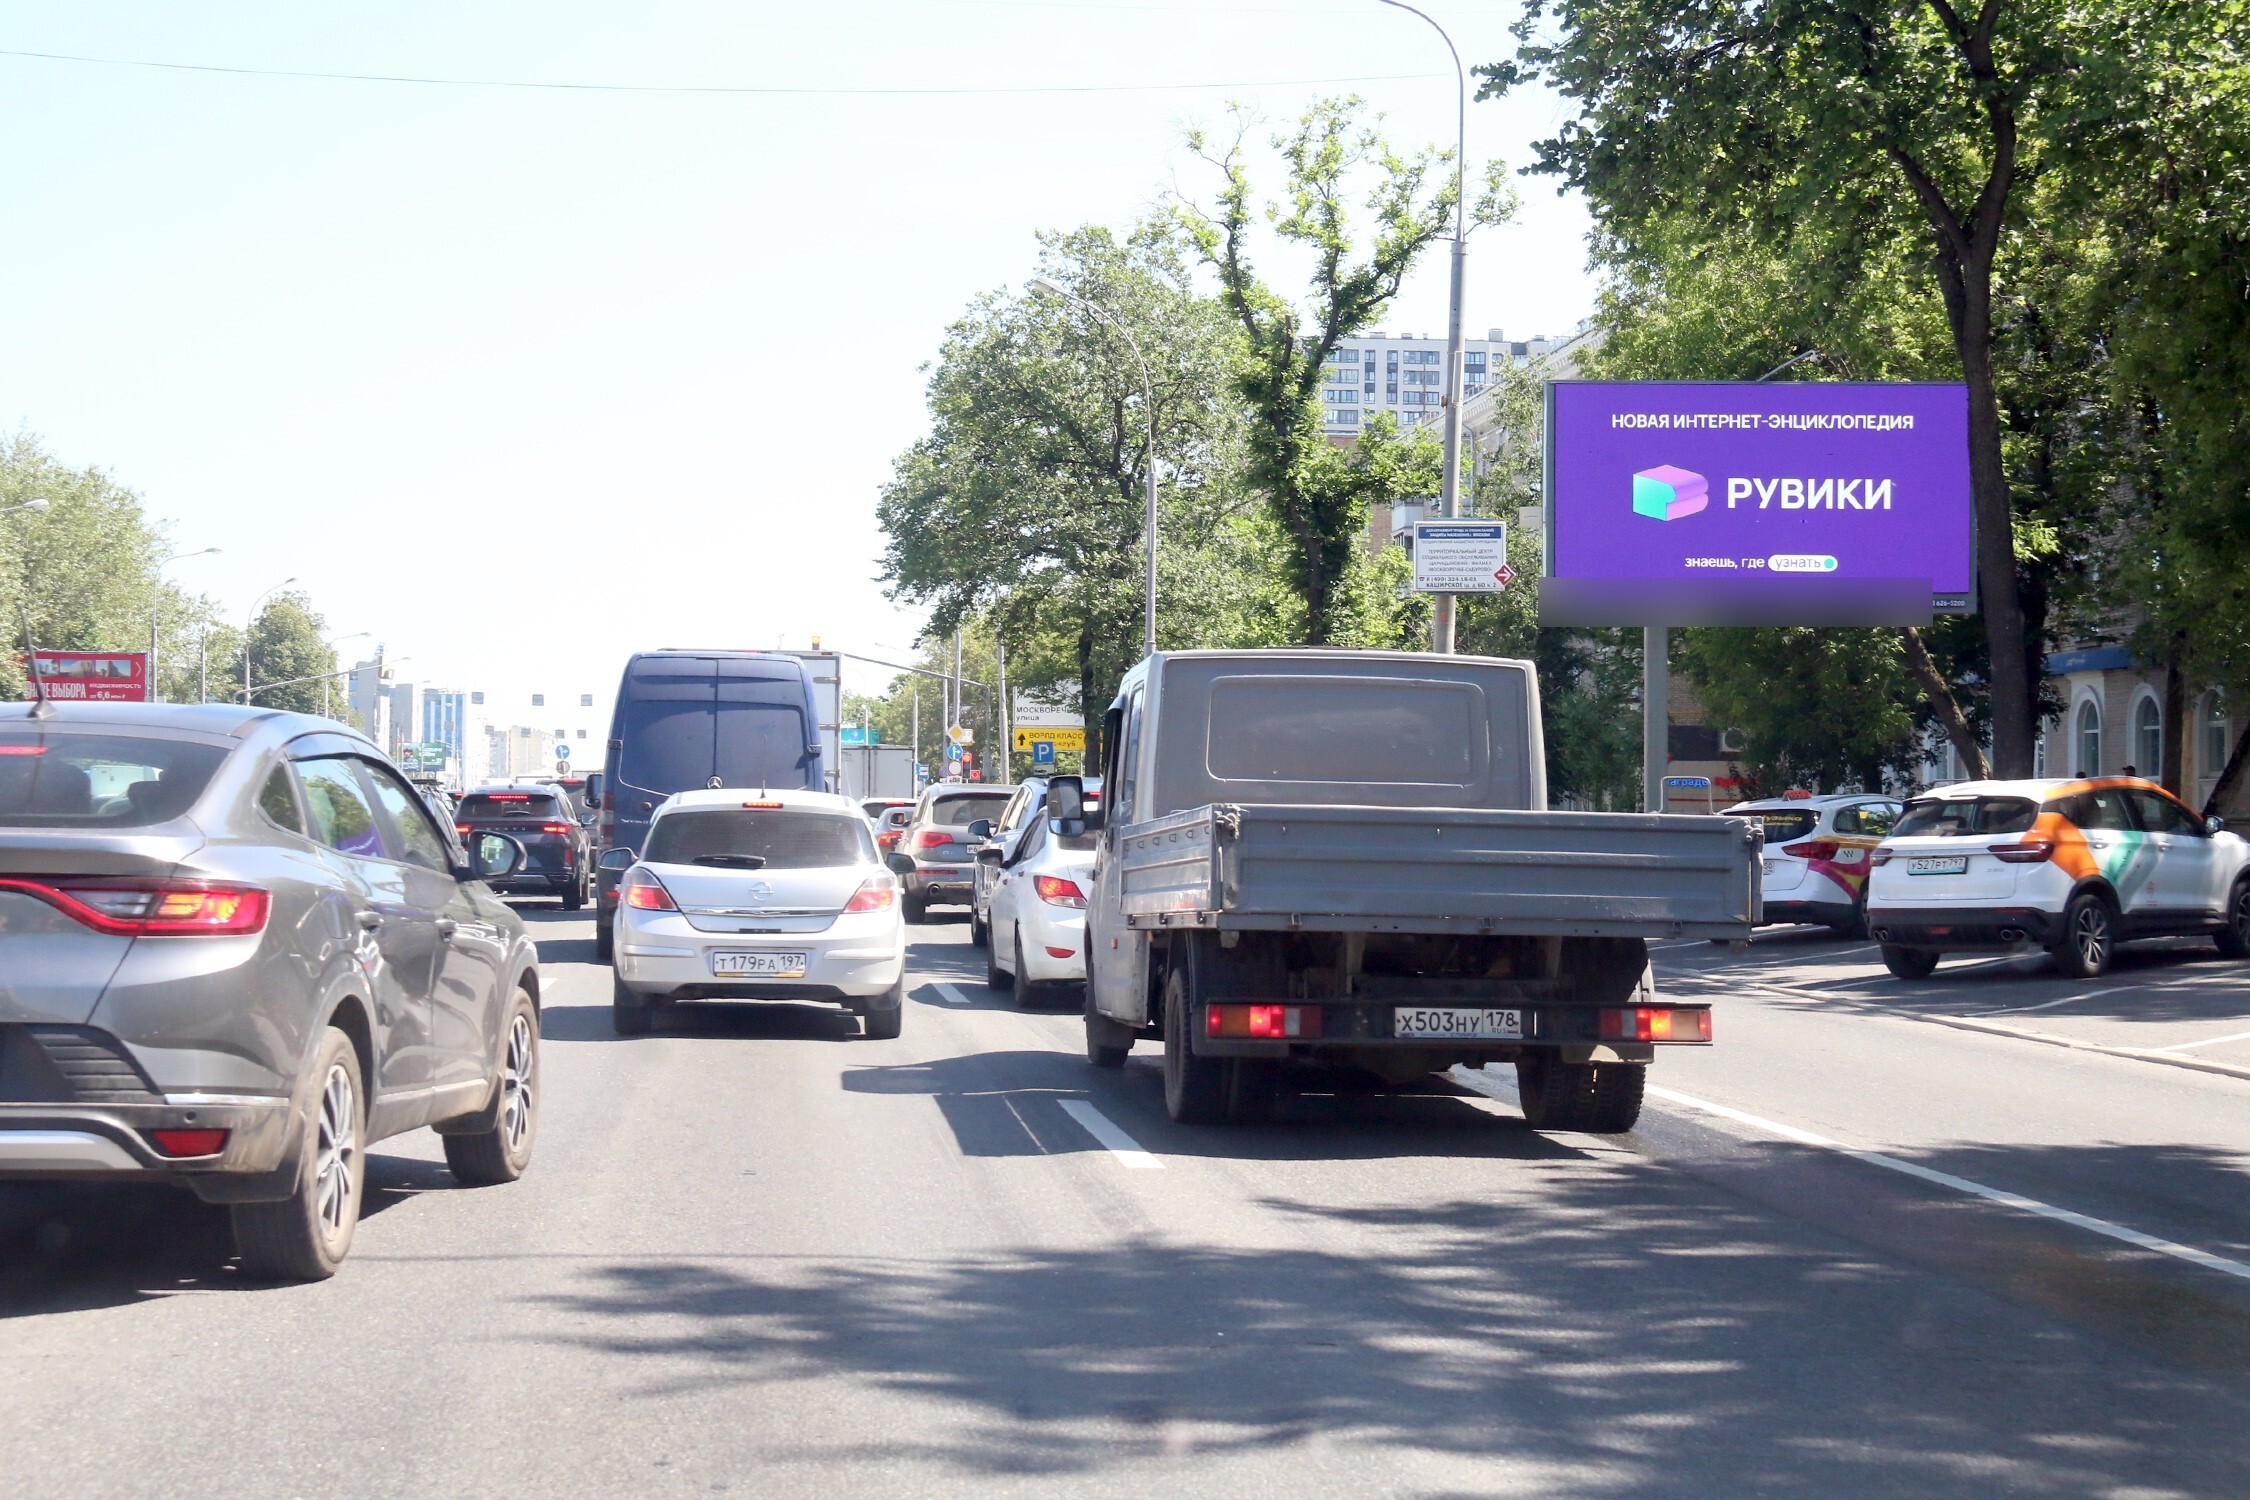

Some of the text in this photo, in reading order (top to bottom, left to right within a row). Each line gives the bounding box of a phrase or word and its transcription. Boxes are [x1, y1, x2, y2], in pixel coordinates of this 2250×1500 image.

[1611, 414, 1914, 431] НОВАЯ ИНТЕРНЕТ-ЭНЦИКЛОПЕДИЯ
[1727, 477, 1892, 510] РУВИКИ
[1684, 557, 1822, 569] знаешь, где узнать
[52, 682, 87, 698] ВЫБОРА
[97, 691, 111, 700] 6,6
[1016, 706, 1074, 714] МОСКВОРЕЧЬ
[719, 955, 801, 970] Т179РА 197
[1401, 1011, 1515, 1033] Х503НУ 178
